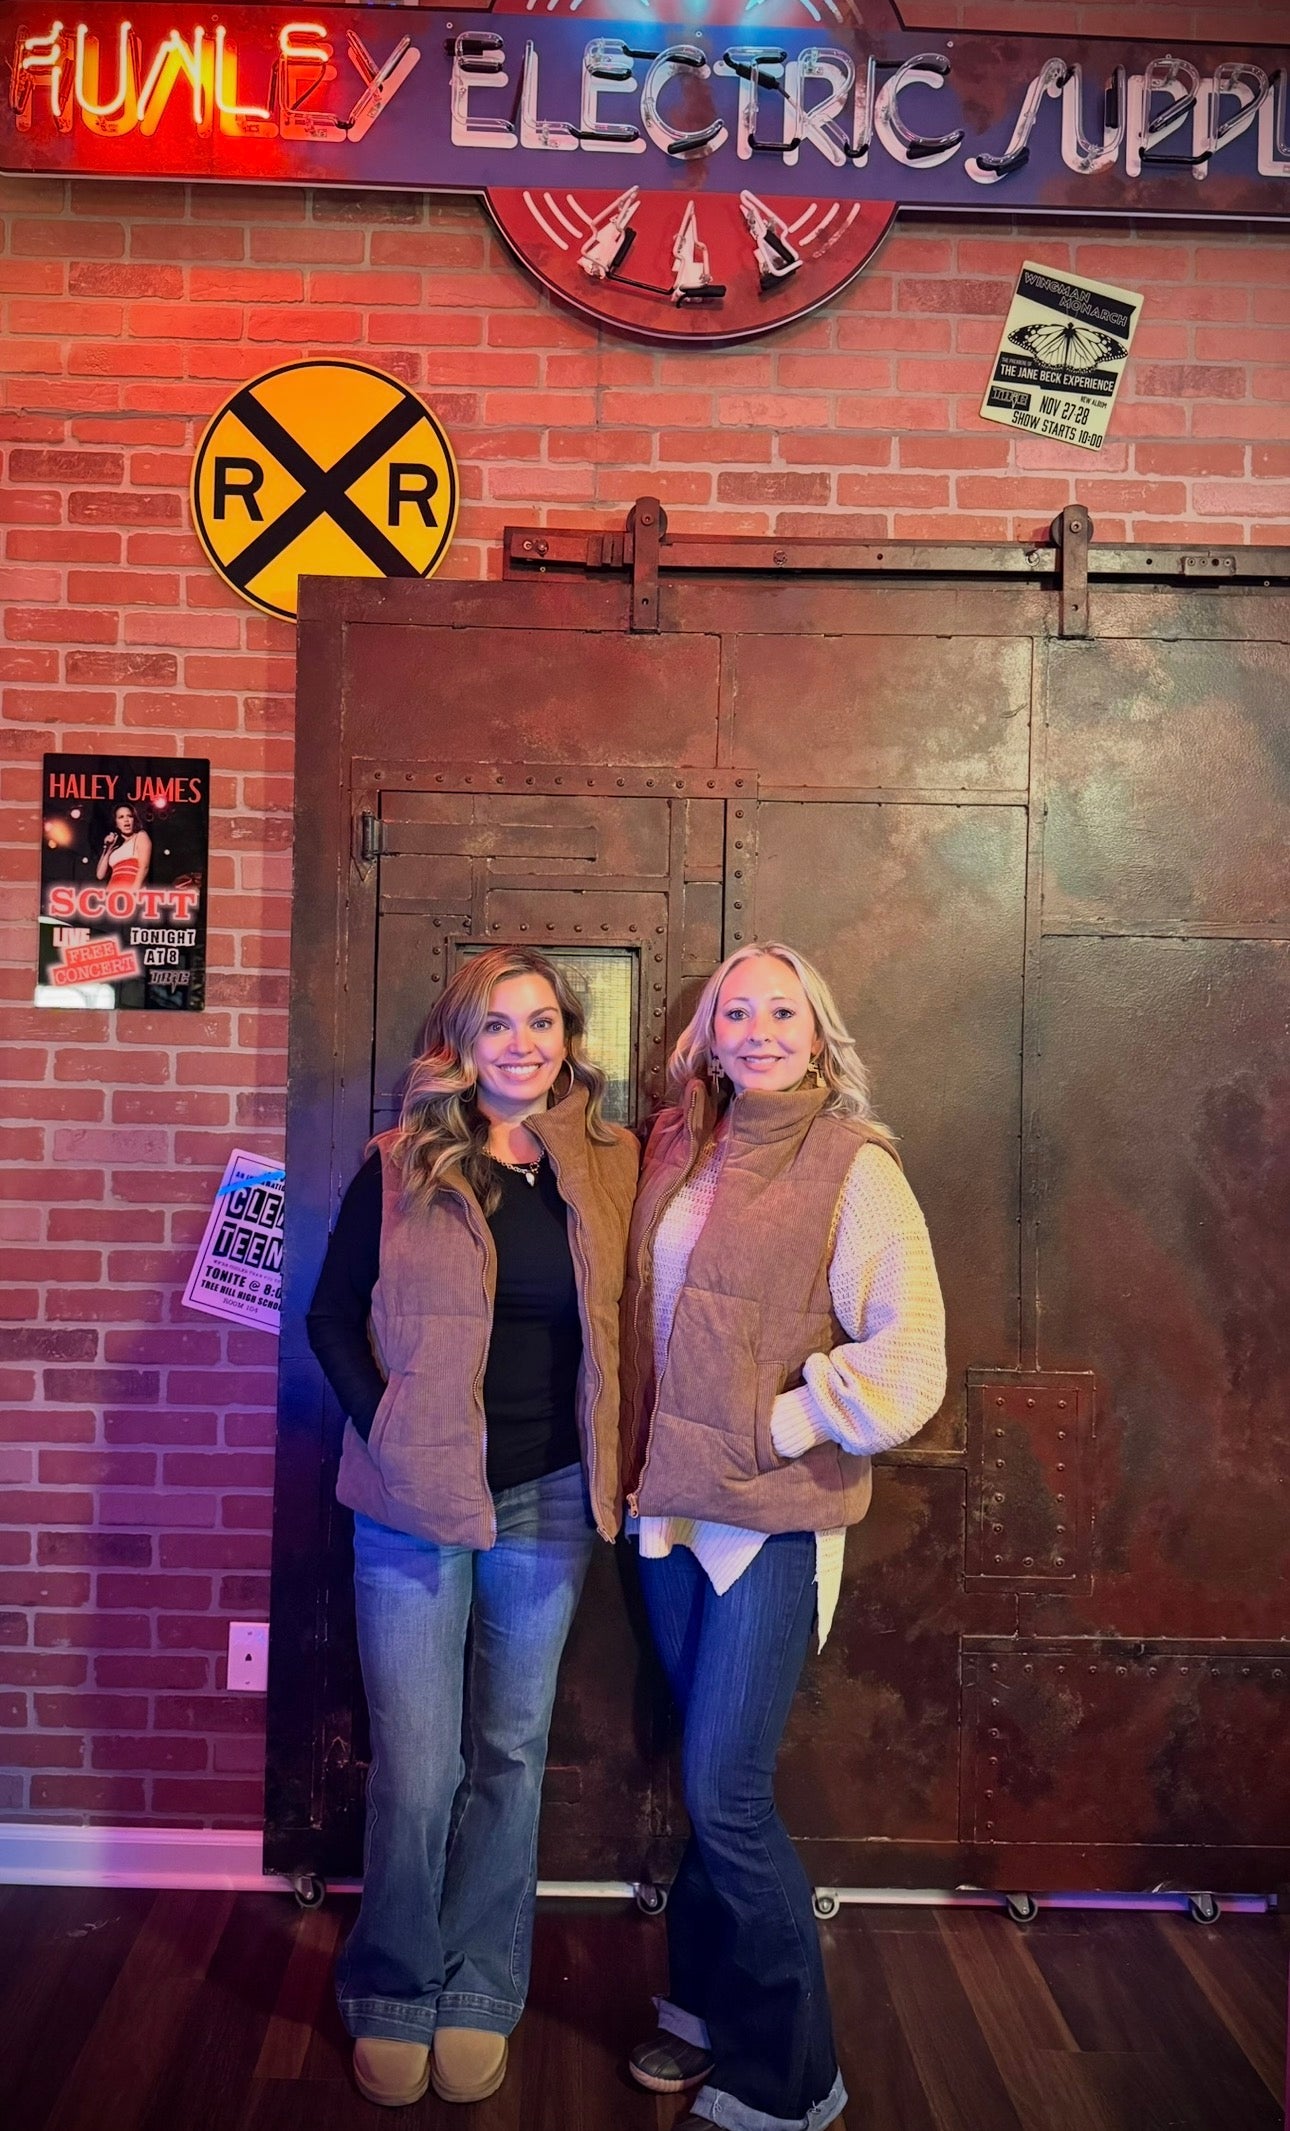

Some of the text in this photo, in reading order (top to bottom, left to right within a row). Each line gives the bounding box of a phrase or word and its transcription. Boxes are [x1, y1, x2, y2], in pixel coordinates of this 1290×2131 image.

[448, 31, 965, 168] ELECTRIC
[1024, 271, 1091, 303] WINGMAN
[1059, 296, 1128, 327] MONARCH
[1000, 364, 1115, 392] THE JANE BECK EXPERIENCE
[1039, 395, 1062, 417] NOV
[1012, 410, 1103, 448] SHOW STARTS 10:00
[213, 456, 438, 527] R R
[50, 773, 202, 803] HALEY JAMES
[50, 886, 198, 920] SCOTT
[130, 927, 196, 946] TONIGHT
[68, 942, 116, 964] FREE
[144, 948, 179, 965] AT 8
[55, 957, 135, 985] CONCERT
[200, 1279, 220, 1292] TREE
[220, 1285, 236, 1297] HILL
[237, 1291, 257, 1303] HIGH
[205, 1265, 247, 1288] TONITE
[249, 1280, 261, 1292] @
[222, 1297, 244, 1309] ROOM
